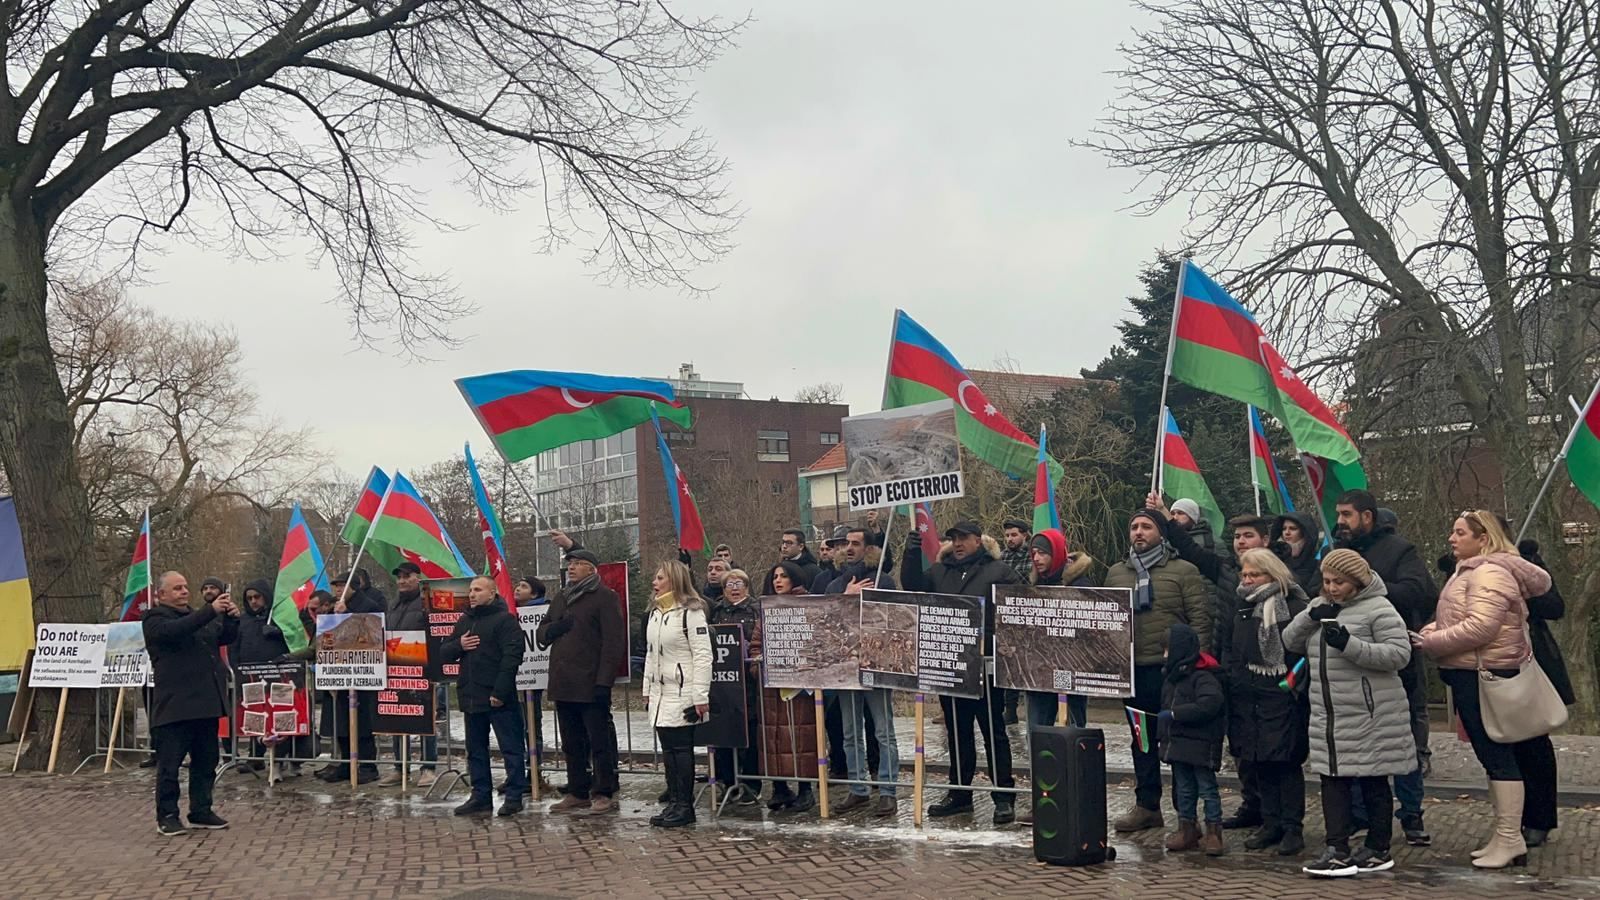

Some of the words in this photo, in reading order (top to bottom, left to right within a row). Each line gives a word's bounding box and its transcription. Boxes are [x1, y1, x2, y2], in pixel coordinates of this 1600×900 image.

[851, 485, 882, 507] STOP
[886, 474, 960, 502] ECOTERROR
[1005, 596, 1015, 606] WE
[1016, 598, 1043, 607] DEMAND
[1043, 599, 1059, 608] THAT
[1060, 600, 1094, 610] ARMENIAN
[1095, 602, 1118, 611] ARMED
[920, 606, 929, 614] WE
[930, 607, 953, 616] DEMAND
[955, 609, 968, 617] THAT
[997, 606, 1020, 615] FORCES
[1021, 607, 1062, 617] RESPONSIBLE
[1063, 610, 1075, 618] FOR
[1076, 610, 1112, 620] NUMEROUS
[1113, 613, 1128, 621] WAR
[429, 613, 462, 623] ARMEN
[518, 613, 547, 625] keep
[920, 615, 949, 624] ARMENIAN
[950, 618, 970, 626] ARMED
[1002, 615, 1025, 624] CRIMES
[1026, 616, 1034, 625] BE
[1035, 617, 1051, 627] HELD
[1052, 618, 1096, 629] ACCOUNTABLE
[1098, 621, 1123, 631] BEFORE
[920, 624, 940, 632] FORCES
[941, 626, 979, 636] RESPONSIBLE
[1046, 627, 1058, 636] THE
[1060, 628, 1075, 637] LAW!
[40, 628, 56, 641] Do
[59, 630, 78, 641] not
[79, 632, 106, 644] forget,
[716, 634, 740, 646] NIA,
[920, 632, 930, 640] FOR
[931, 633, 961, 643] NUMEROUS
[962, 636, 976, 645] WAR
[38, 646, 58, 656] YOU
[59, 647, 78, 656] ARE
[920, 641, 940, 649] CRIMES
[941, 643, 948, 651] BE
[949, 644, 964, 653] HELD
[318, 651, 339, 664] STOP
[530, 654, 549, 662] autho
[920, 650, 958, 660] ACCOUNTABLE
[108, 654, 124, 672] LET
[126, 654, 142, 672] THE
[920, 658, 940, 667] BEFORE
[942, 660, 952, 669] THE
[322, 667, 352, 675] PLUNDERING
[353, 666, 375, 675] NATURAL
[389, 666, 423, 677] MENIAN
[443, 664, 460, 674] CRI
[101, 673, 130, 684] ECOLOGISTS
[130, 673, 143, 684] PASS
[317, 678, 344, 686] RESOURCES
[346, 678, 352, 686] OF
[353, 678, 382, 686] AZERBAIJAN
[712, 671, 739, 682] CKS!
[389, 679, 429, 690] NDMINES
[378, 691, 398, 702] KILL
[378, 704, 424, 716] CIVILIANS!
